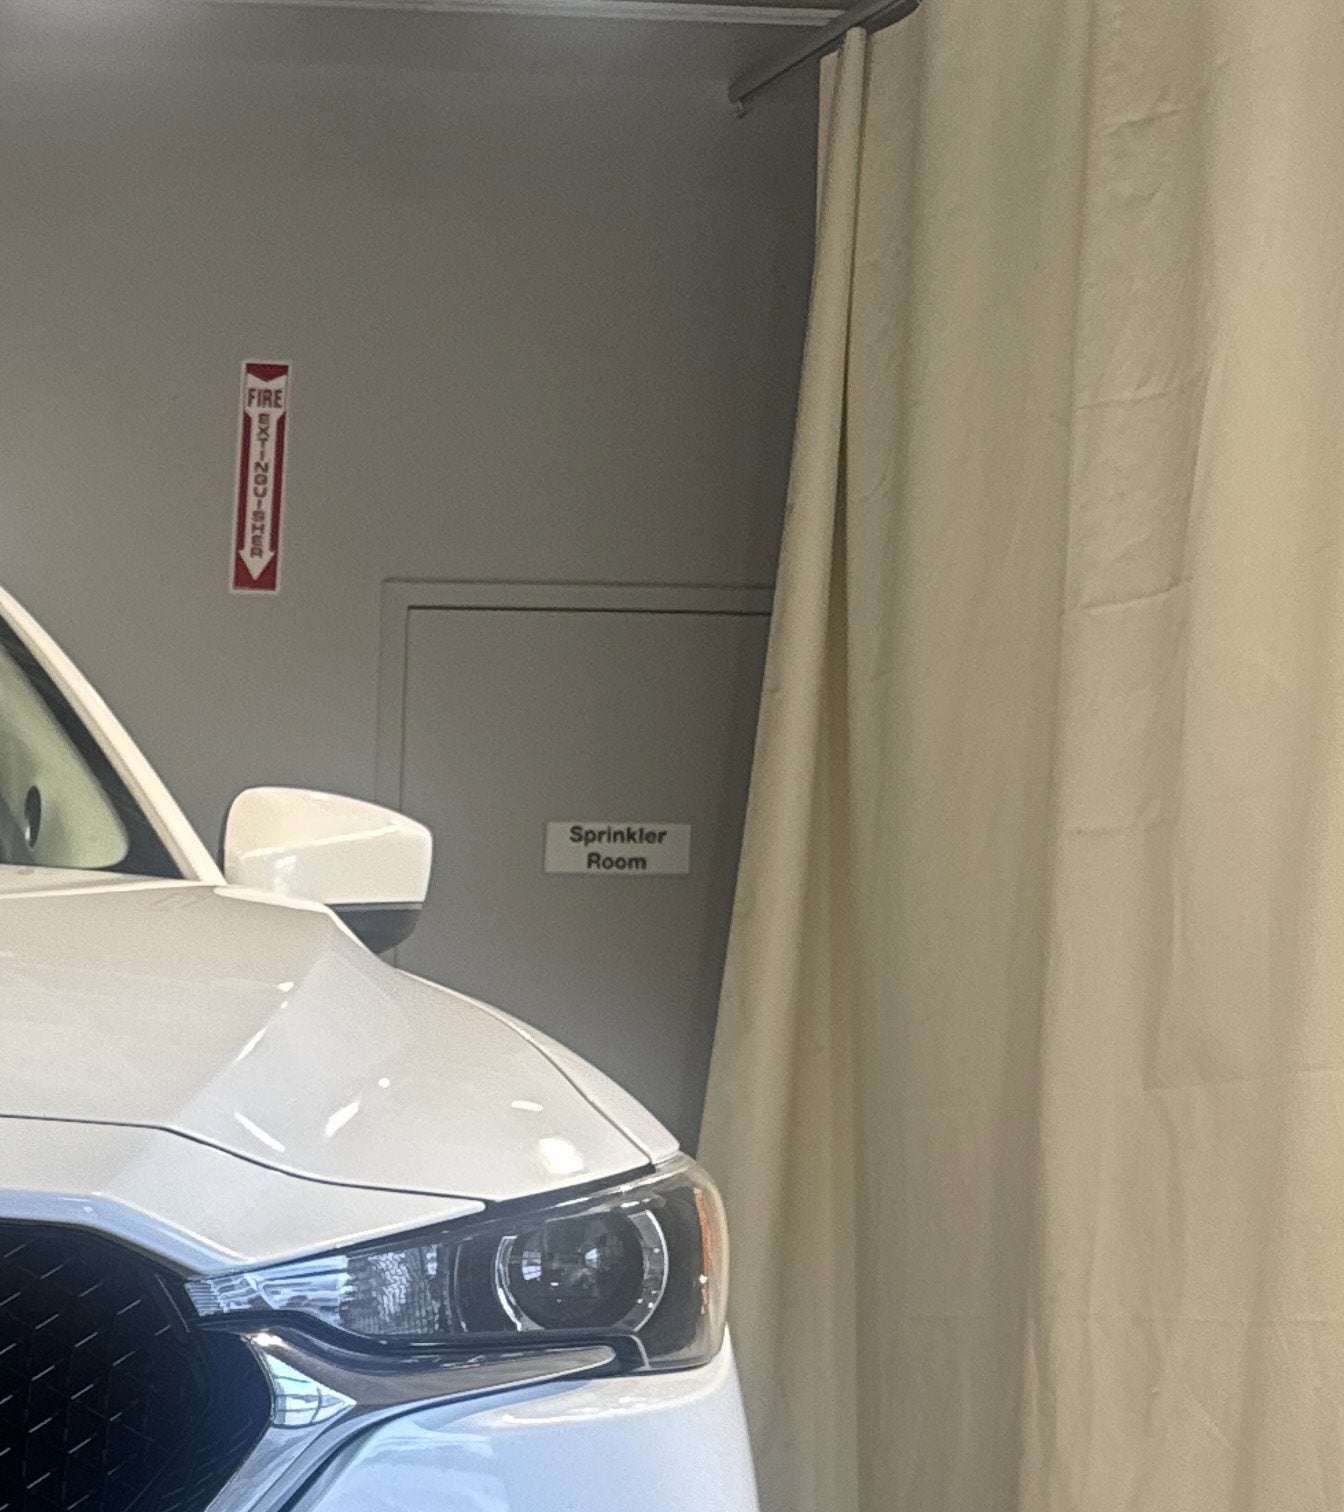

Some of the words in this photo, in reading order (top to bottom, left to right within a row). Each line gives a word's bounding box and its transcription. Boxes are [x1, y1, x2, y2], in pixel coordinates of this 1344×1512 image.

[247, 388, 283, 409] FIRE
[250, 413, 271, 559] EXTINGUISHER
[569, 825, 667, 847] Sprinkler
[587, 852, 647, 870] Room
